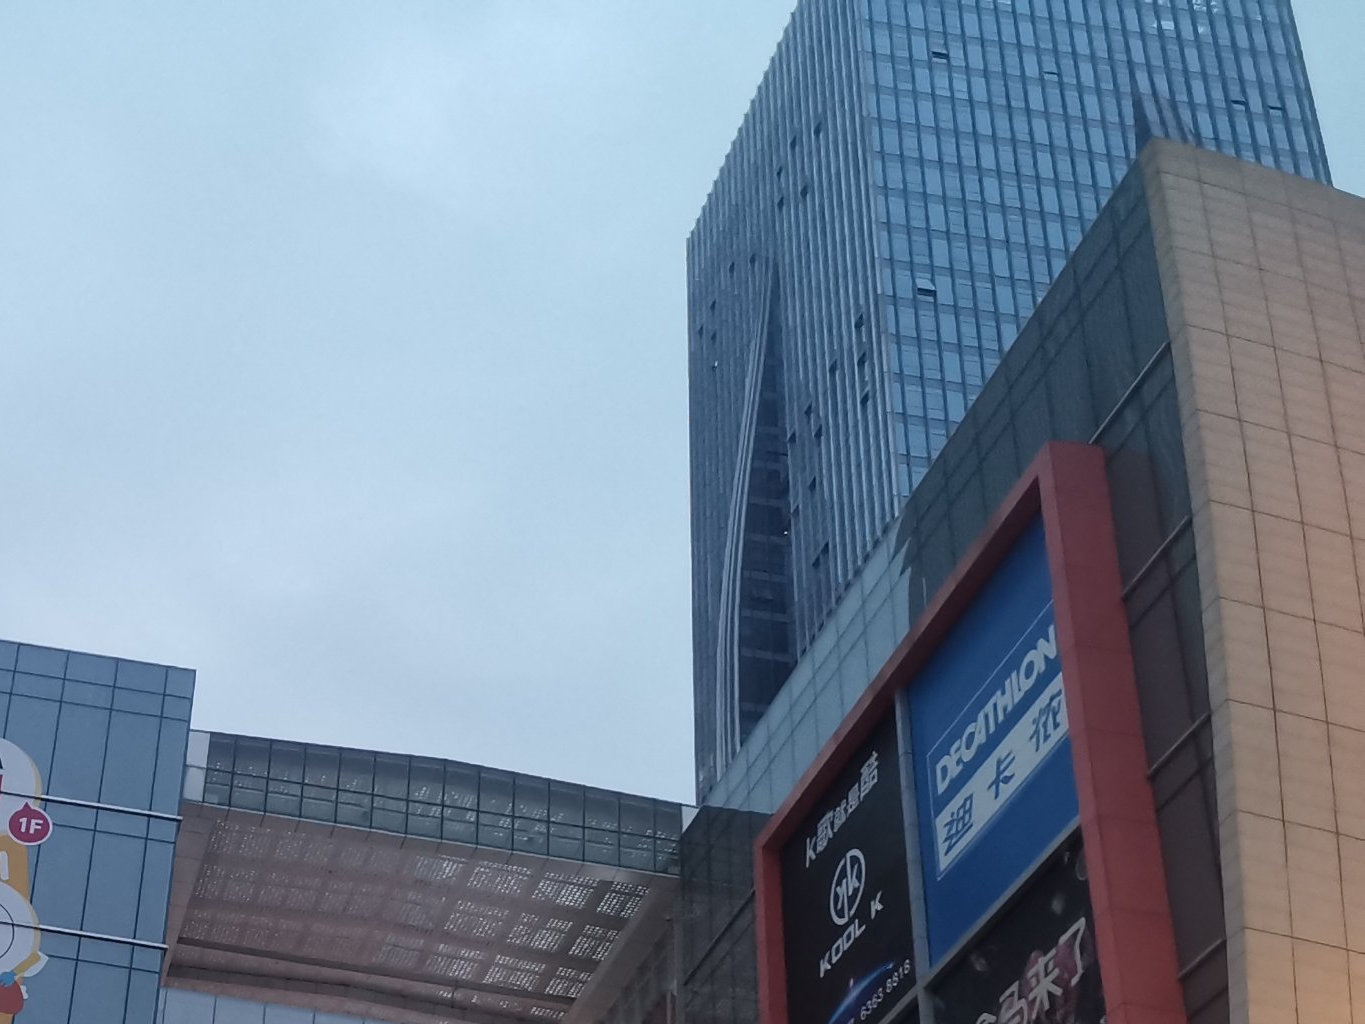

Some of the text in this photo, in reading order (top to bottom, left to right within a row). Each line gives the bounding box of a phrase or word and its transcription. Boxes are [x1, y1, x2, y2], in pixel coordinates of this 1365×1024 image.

[936, 625, 1058, 795] DECATHLON
[943, 689, 1063, 856] 迪卡侬
[19, 817, 43, 834] 1F
[819, 891, 884, 978] KOOL K
